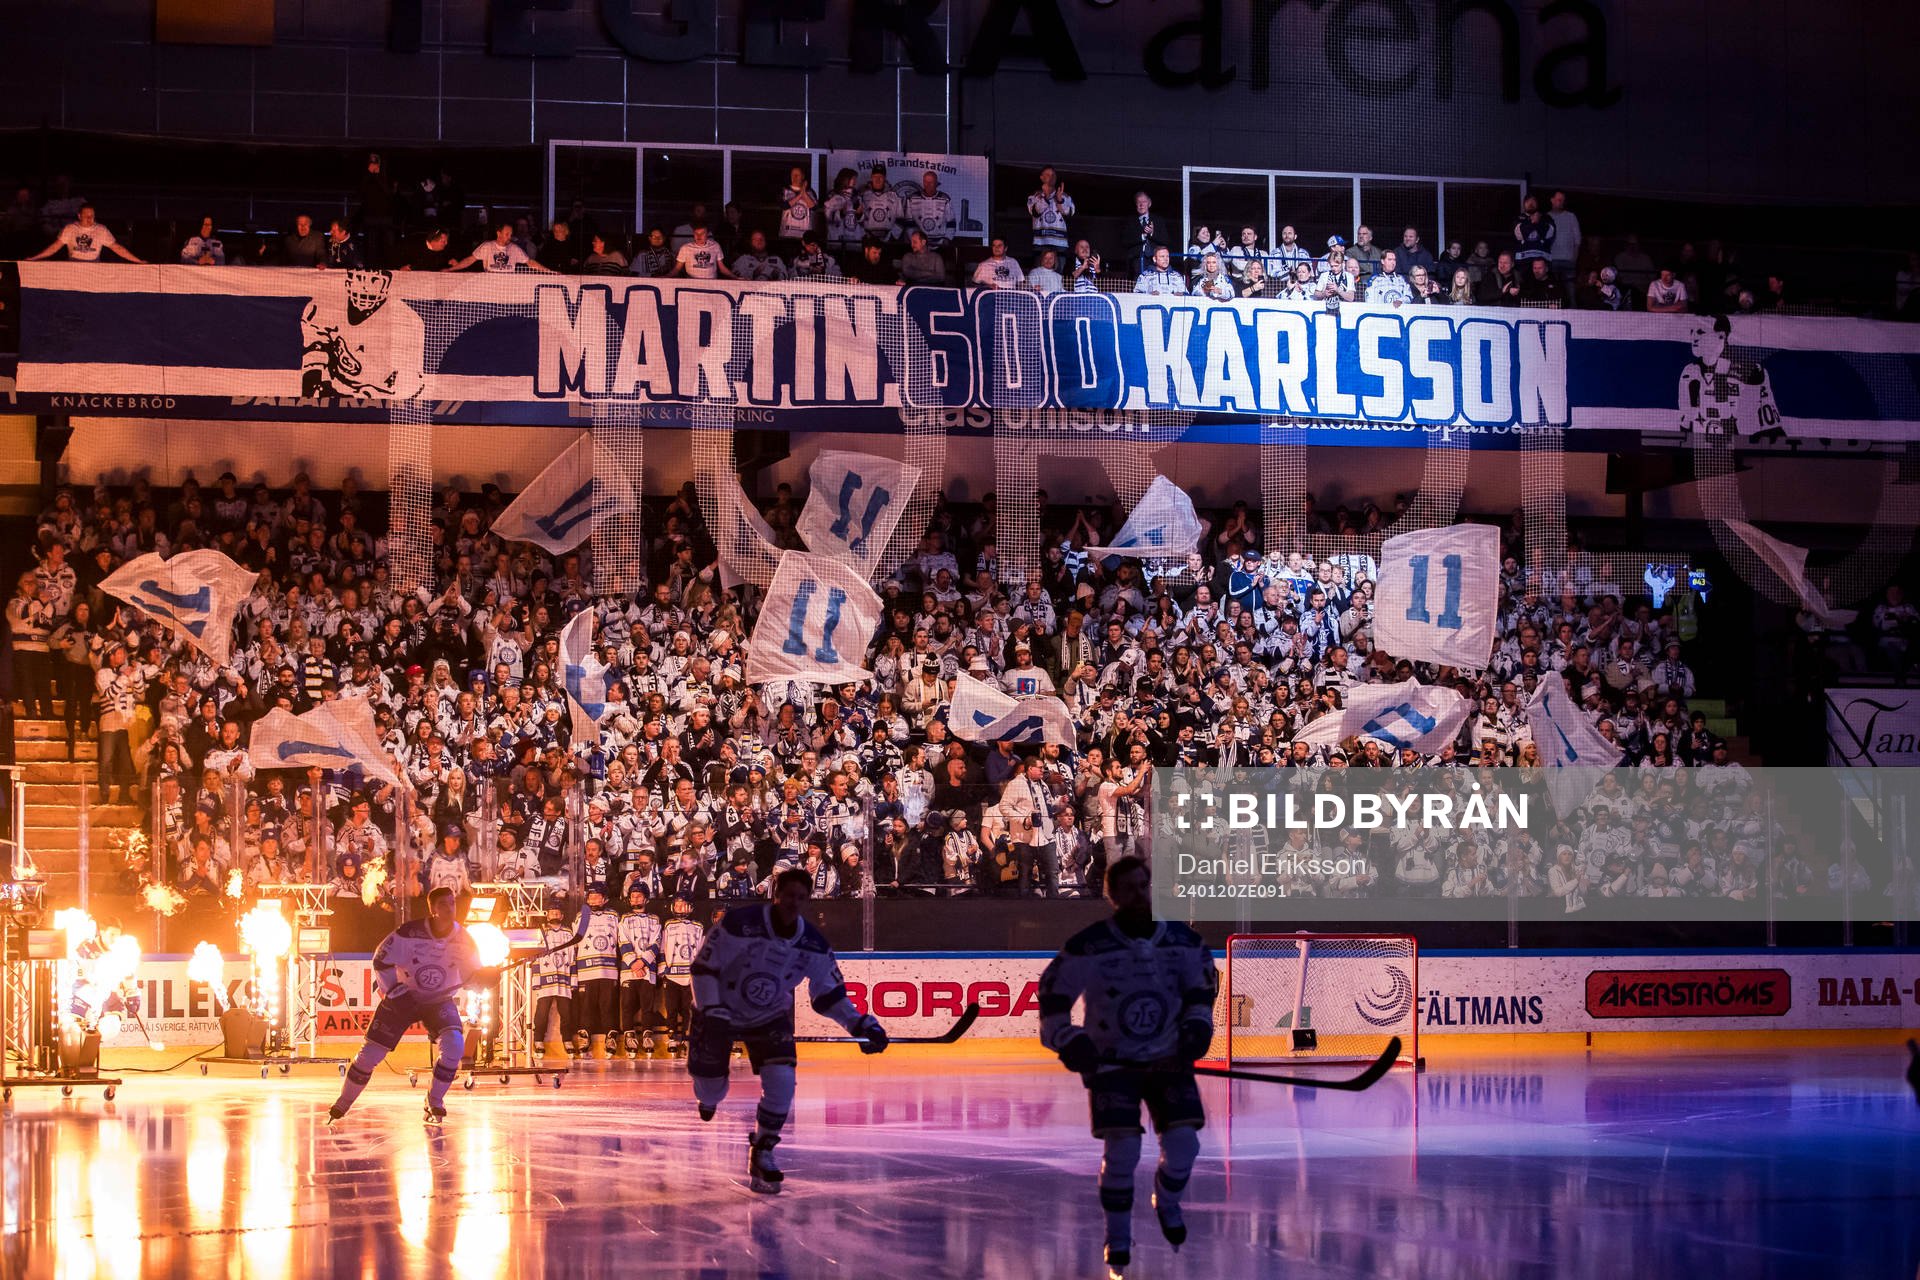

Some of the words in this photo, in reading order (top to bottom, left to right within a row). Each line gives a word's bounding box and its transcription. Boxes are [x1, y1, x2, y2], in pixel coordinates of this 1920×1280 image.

[887, 157, 957, 175] Brandstation
[534, 284, 884, 406] MARTIN
[902, 286, 1124, 410] 600
[1138, 306, 1571, 429] KARLSSON
[1407, 553, 1463, 628] 11
[782, 578, 847, 665] 11
[1599, 976, 1776, 1007] ÅKERSTRÖMS
[1817, 977, 1920, 1006] DALA-
